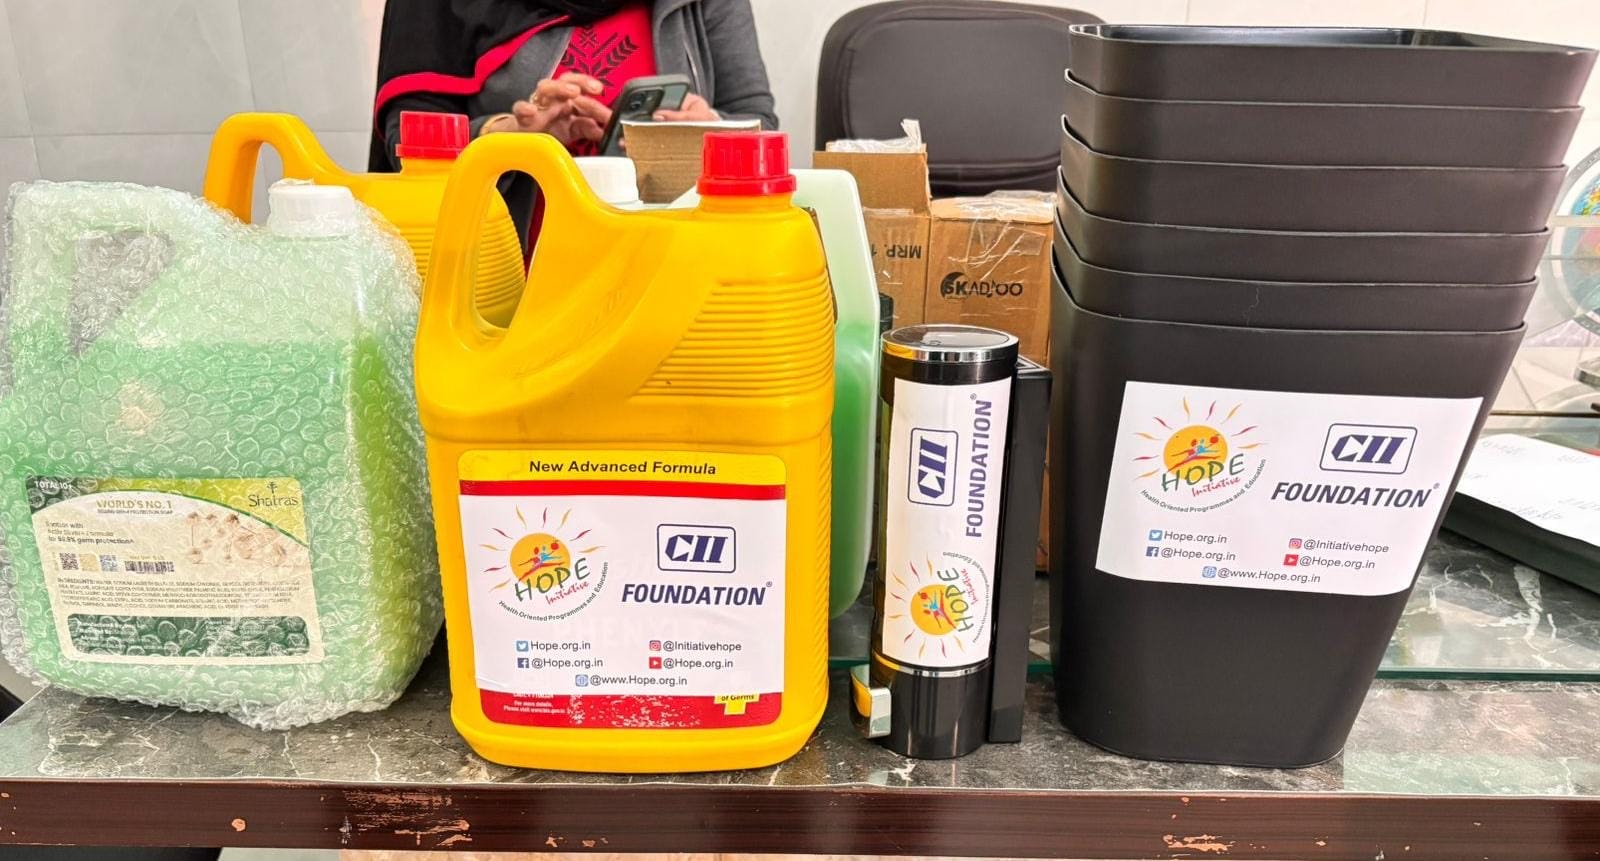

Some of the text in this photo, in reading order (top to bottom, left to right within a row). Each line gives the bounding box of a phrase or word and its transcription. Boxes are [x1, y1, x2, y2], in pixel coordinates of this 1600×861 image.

[1331, 433, 1408, 465] CII
[529, 460, 717, 475] New Advanced Formula
[917, 435, 948, 499] CII
[1161, 453, 1245, 492] HOPE
[1141, 489, 1160, 505] Health
[1233, 488, 1245, 500] and
[1245, 458, 1267, 489] Education
[1191, 477, 1241, 497] Initiative
[96, 499, 144, 509] WORLD'S
[1163, 530, 1228, 545] Hope.org.in
[664, 534, 729, 564] CII
[1303, 538, 1390, 554] @Initiativehope
[1160, 547, 1236, 562] @Hope.org.in
[1299, 555, 1376, 570] @Hope.org.in
[514, 557, 591, 602] HOPE
[1217, 567, 1322, 584] @www.Hope.org.in
[498, 600, 519, 616] Health
[586, 592, 597, 604] and
[594, 561, 609, 593] Education
[936, 567, 975, 632] HOPE
[530, 640, 591, 652] Hope.org.in
[662, 640, 742, 652] @Initiativehope
[531, 658, 604, 669] @Hope.org.in
[663, 658, 734, 670] @Hope.org.in
[589, 675, 688, 687] @www.Hope.org.in
